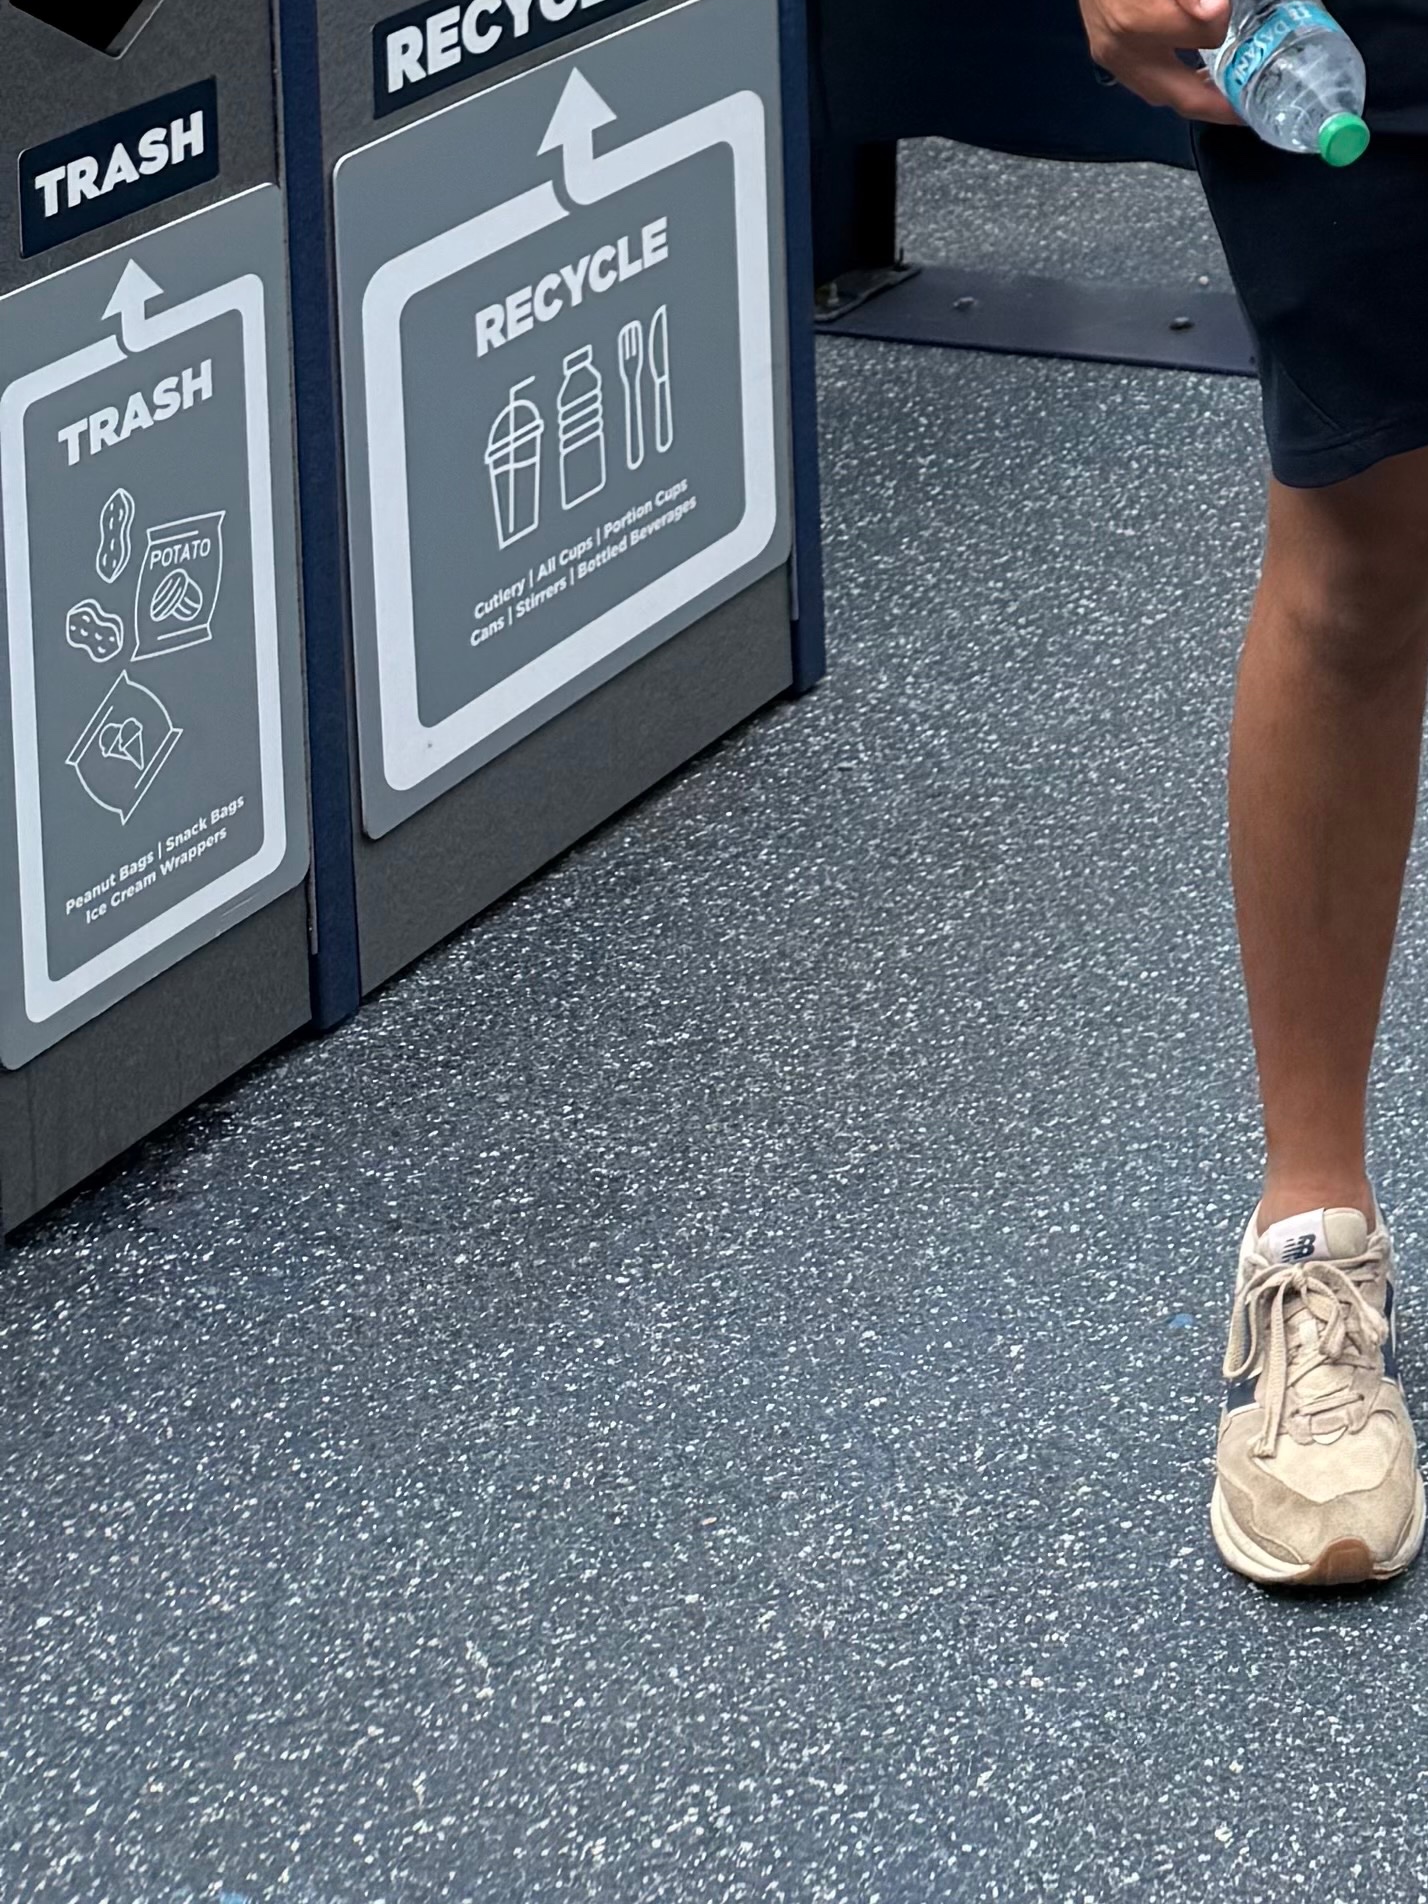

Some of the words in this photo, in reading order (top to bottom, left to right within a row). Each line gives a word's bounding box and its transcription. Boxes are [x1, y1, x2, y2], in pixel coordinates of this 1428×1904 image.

[34, 109, 205, 218] TRASH
[475, 216, 670, 357] RECYCLE
[58, 357, 215, 467] TRASH
[148, 537, 212, 570] POTATO
[470, 615, 505, 647] Cans
[515, 576, 568, 619] Stirrers
[577, 538, 628, 579] Bottled
[630, 495, 697, 547] Beverages
[474, 577, 525, 619] Cutlery
[537, 557, 556, 581] All
[559, 536, 593, 566] Cups
[603, 500, 653, 539] Portion
[655, 478, 689, 508] Cups
[65, 873, 117, 916] Peanut
[119, 850, 154, 882] Bags
[165, 817, 208, 853] Snack
[210, 795, 245, 824] Bags
[86, 903, 107, 924] Ice
[110, 871, 156, 908] Cream
[160, 826, 228, 876] Wrappers
